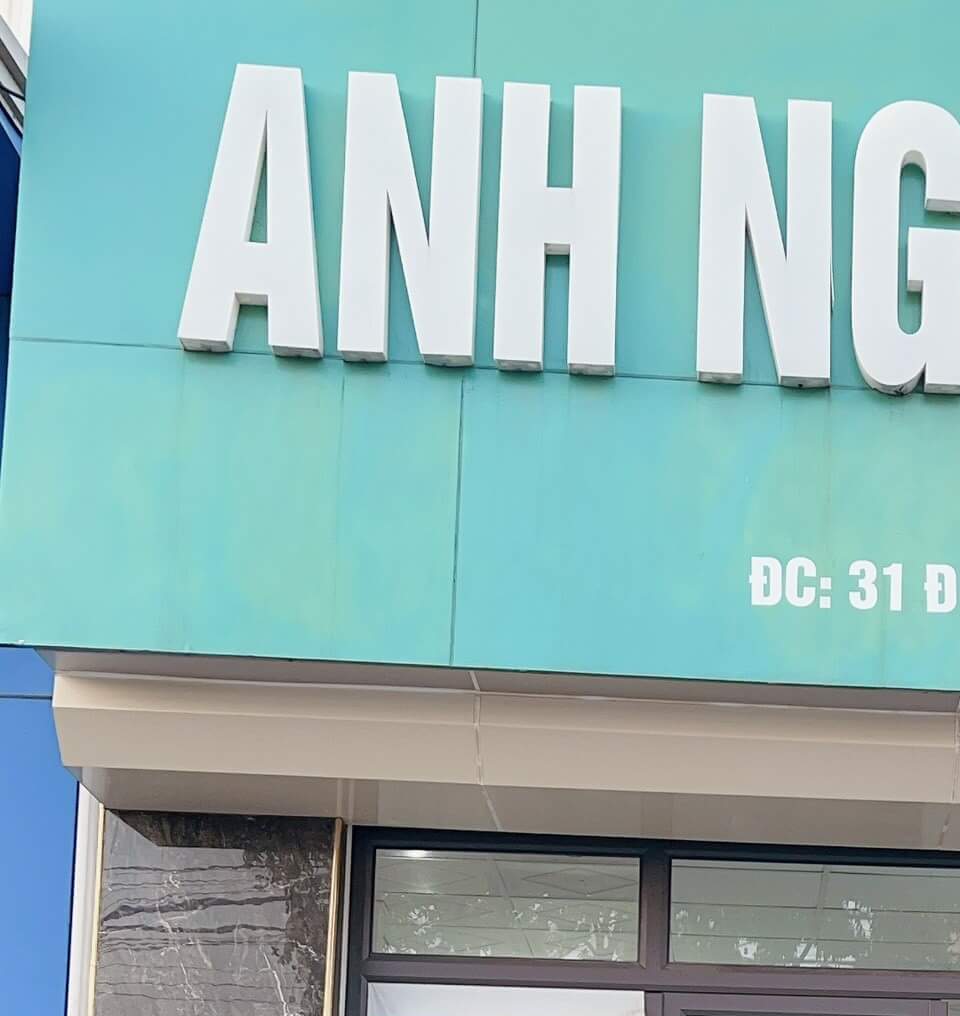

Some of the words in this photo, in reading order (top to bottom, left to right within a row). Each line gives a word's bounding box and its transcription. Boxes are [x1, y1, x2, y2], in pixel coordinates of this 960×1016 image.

[177, 63, 622, 376] ANH
[749, 556, 832, 608] ĐC:
[848, 560, 903, 611] 31
